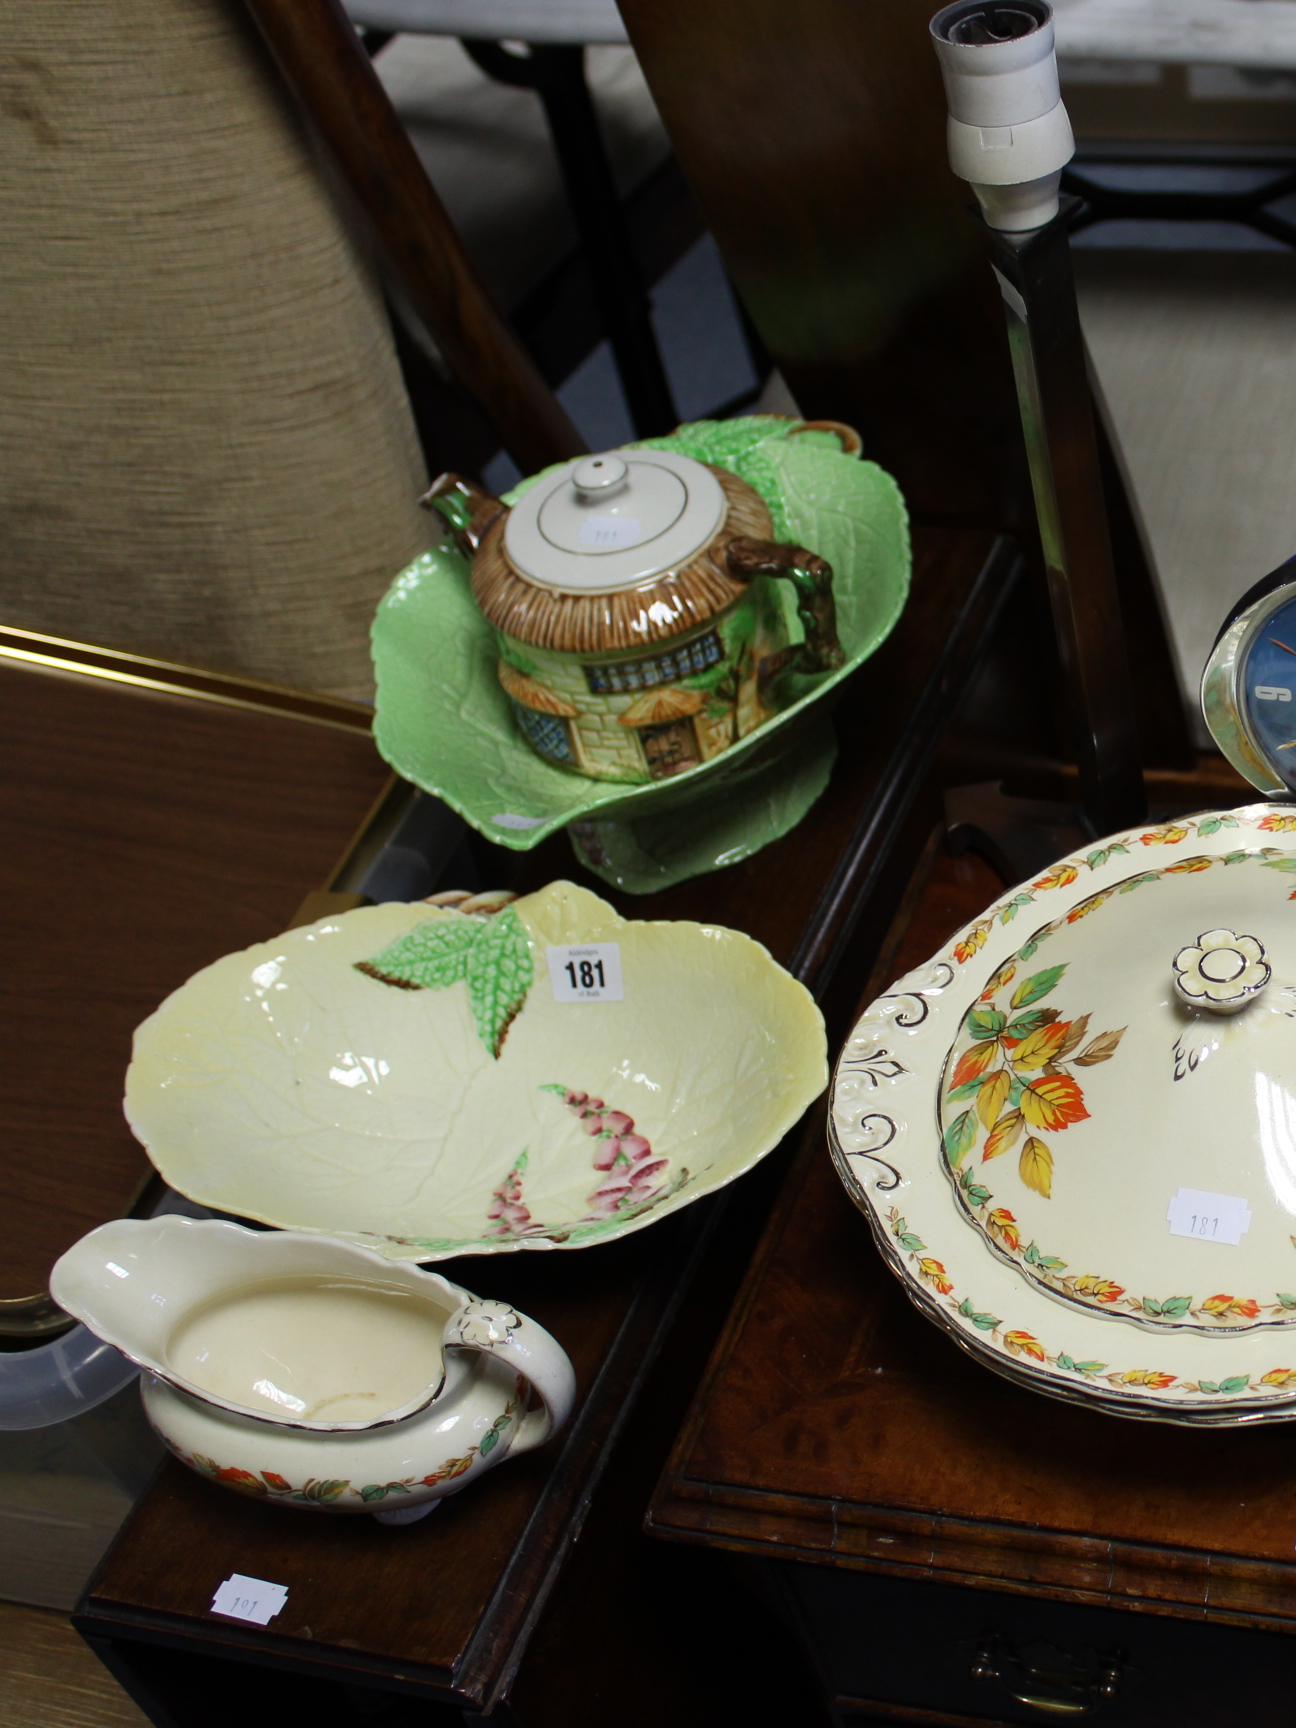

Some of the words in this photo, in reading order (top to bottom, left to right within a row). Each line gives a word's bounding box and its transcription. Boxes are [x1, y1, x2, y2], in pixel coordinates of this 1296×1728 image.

[1254, 685, 1292, 702] 9
[568, 949, 598, 957] Aldridges
[564, 959, 606, 989] 181
[586, 990, 600, 998] Bath
[1190, 1214, 1219, 1237] 181
